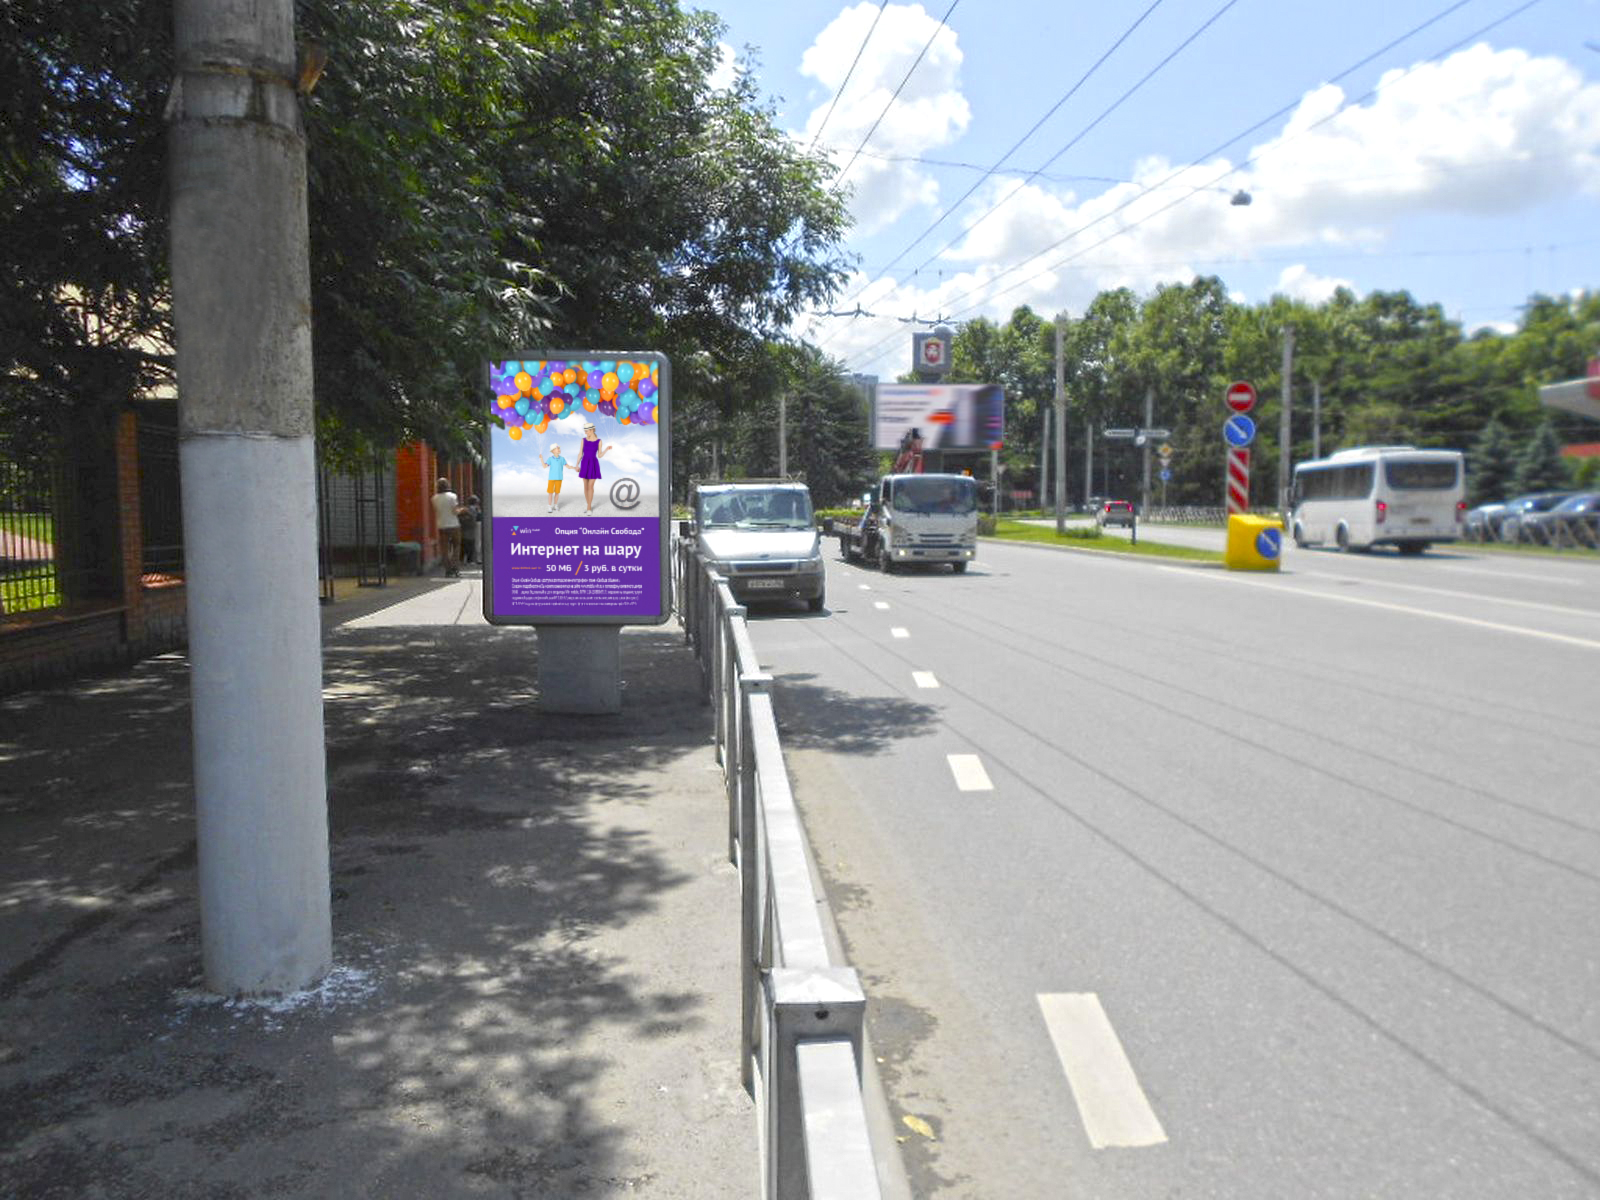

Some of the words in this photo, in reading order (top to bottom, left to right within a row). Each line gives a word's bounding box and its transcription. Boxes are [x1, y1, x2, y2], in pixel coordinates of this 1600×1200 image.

[610, 478, 641, 510] @
[554, 527, 579, 536] Опция
[510, 543, 580, 558] Интернет
[582, 545, 600, 556] на
[604, 545, 642, 558] шару
[546, 564, 557, 572] 50
[584, 564, 590, 572] 3
[592, 564, 610, 574] руб.
[618, 565, 643, 574] сутки
